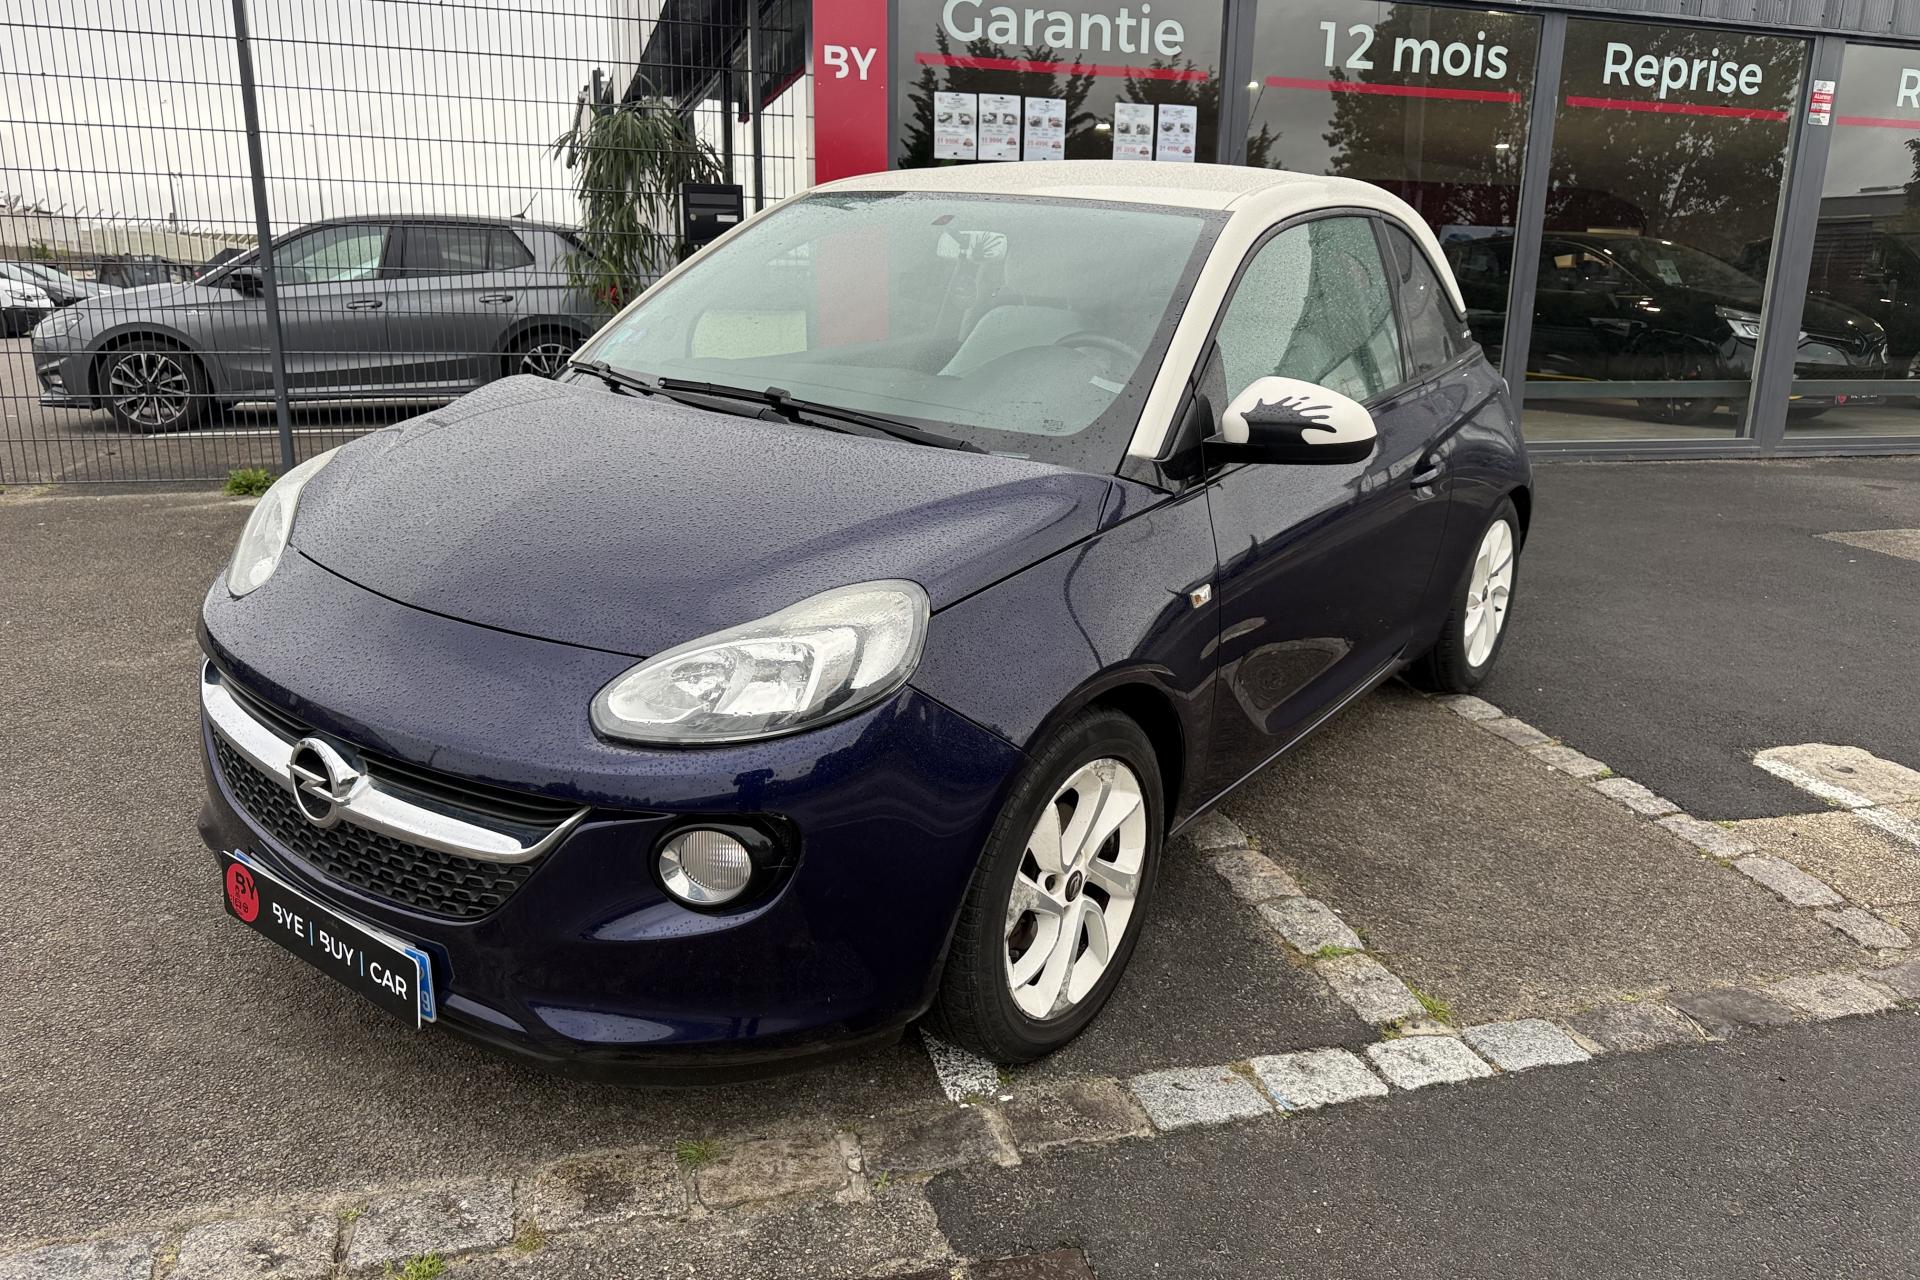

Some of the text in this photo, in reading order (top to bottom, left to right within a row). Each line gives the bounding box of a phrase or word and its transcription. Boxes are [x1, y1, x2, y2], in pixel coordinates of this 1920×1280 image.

[942, 0, 1186, 57] Garantie
[1319, 19, 1510, 80] 12 mois
[823, 44, 878, 81] BY
[1603, 42, 1764, 100] Reprise
[235, 871, 256, 900] BY
[272, 902, 408, 1000] BYE BUY CAR
